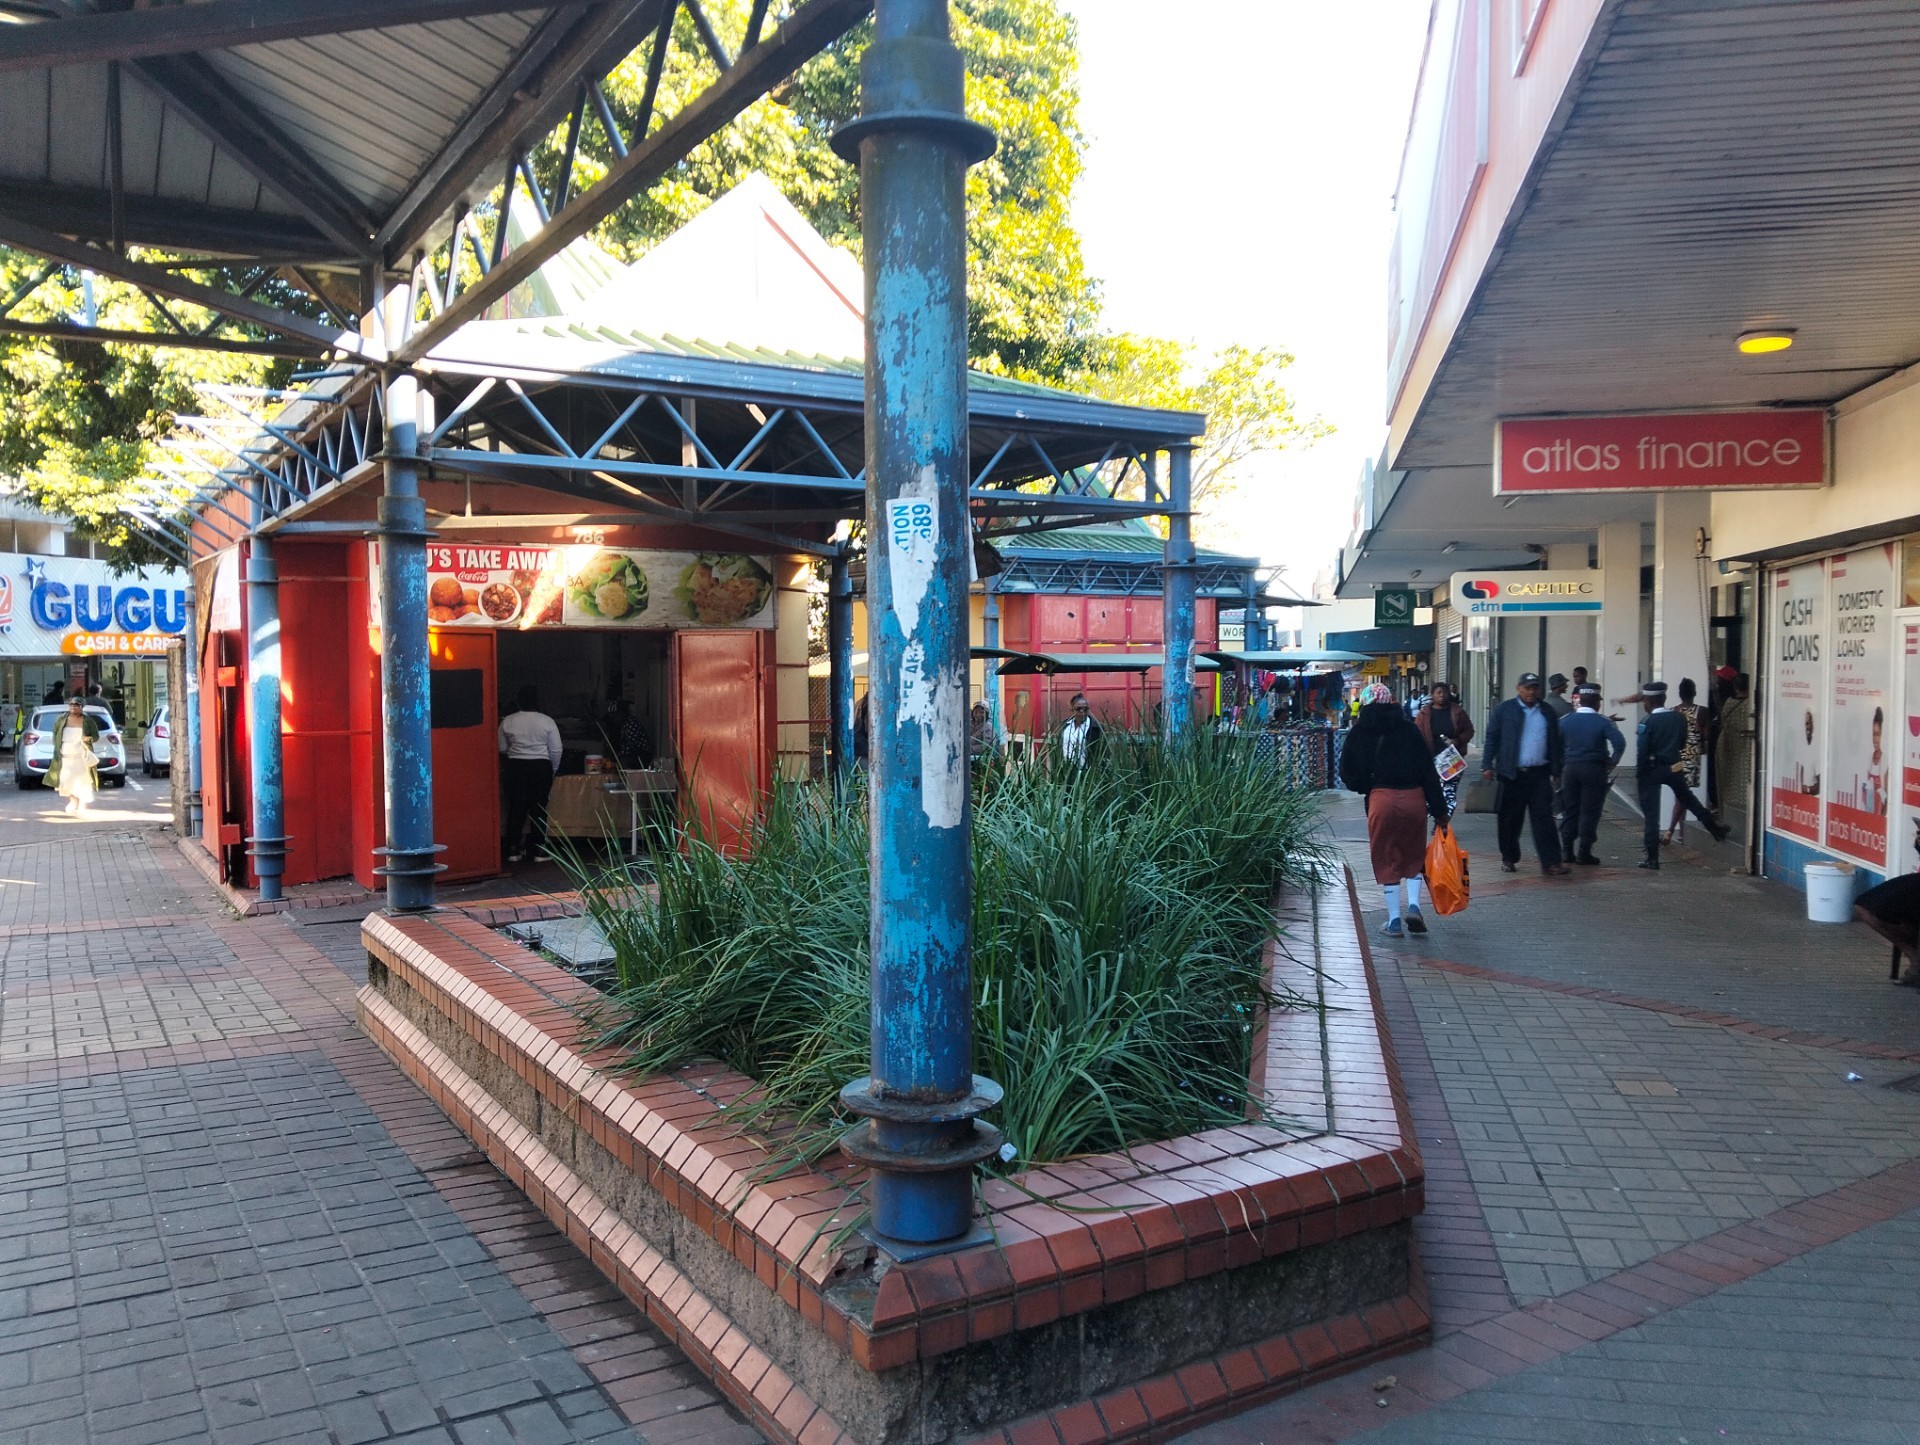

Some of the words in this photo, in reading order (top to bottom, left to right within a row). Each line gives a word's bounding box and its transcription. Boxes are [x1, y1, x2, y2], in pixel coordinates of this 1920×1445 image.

[1522, 438, 1620, 474] atlas
[1637, 436, 1801, 471] finance
[457, 549, 501, 569] TAKE
[1507, 582, 1594, 596] CAPITEC
[1838, 589, 1884, 611] DOMESTIC
[30, 581, 187, 633] GUGU
[1471, 602, 1499, 612] atm
[1783, 598, 1813, 627] CASH
[1838, 615, 1875, 634] WORKER
[74, 635, 115, 651] CASH
[119, 636, 130, 650] &
[1782, 634, 1819, 661] LOANS
[1837, 639, 1865, 657] LOANS
[1775, 801, 1792, 821] atlas
[1792, 804, 1820, 830] finance
[1828, 817, 1849, 841] atlas
[1850, 821, 1886, 853] finance
